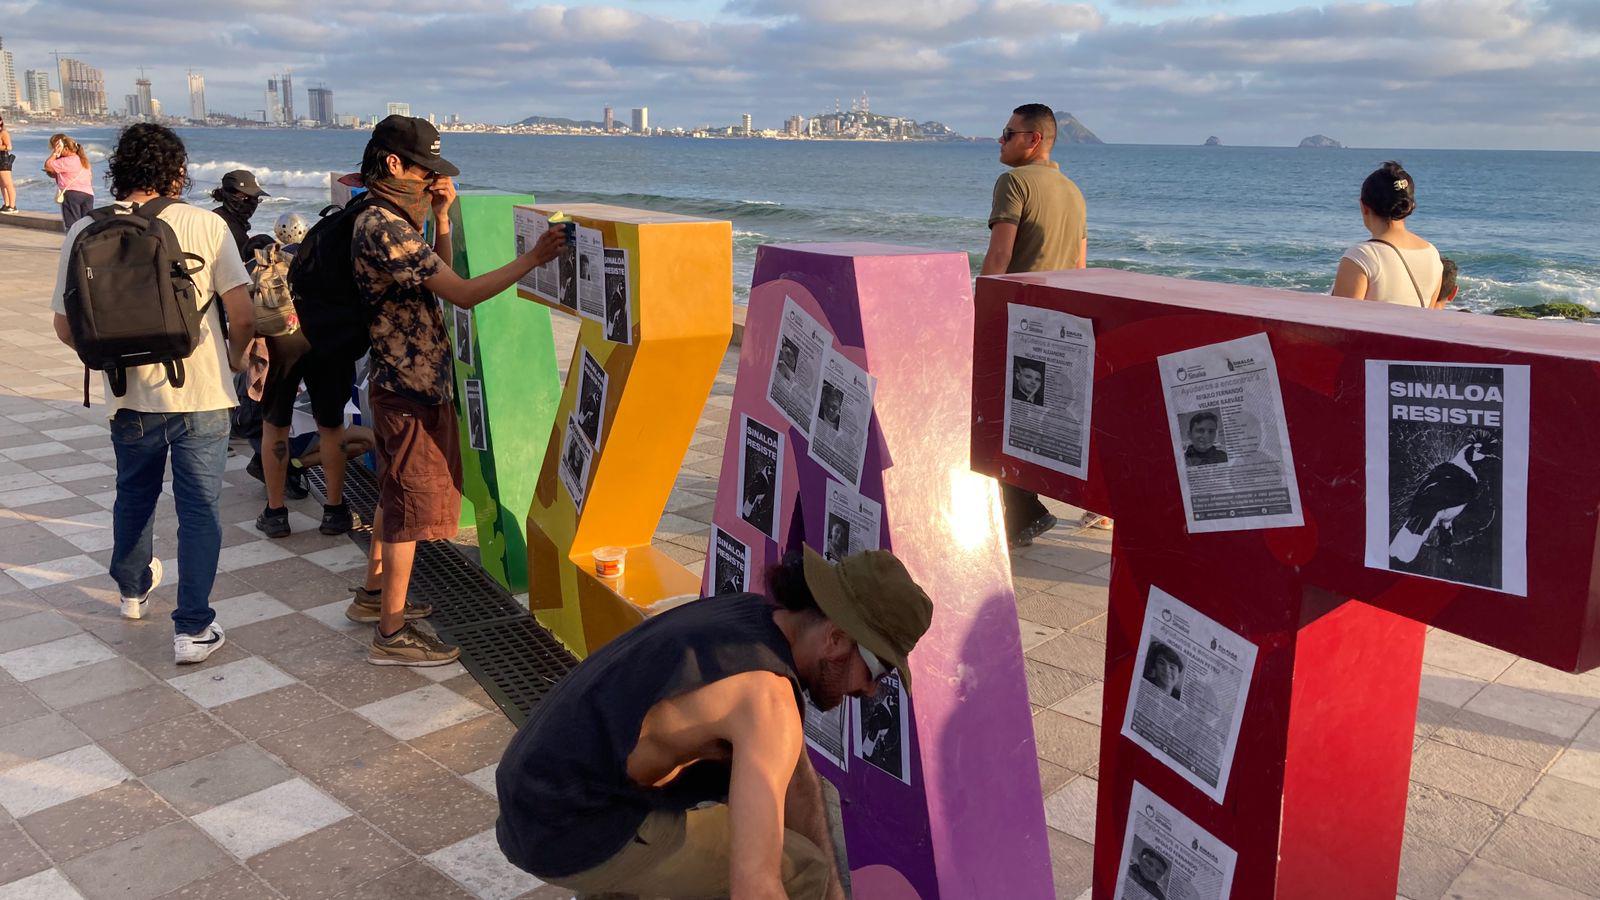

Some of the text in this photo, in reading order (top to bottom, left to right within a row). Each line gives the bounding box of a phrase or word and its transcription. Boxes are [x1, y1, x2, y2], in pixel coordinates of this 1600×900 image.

[1390, 381, 1503, 402] SINALOA
[1392, 404, 1501, 427] RESISTE
[746, 426, 778, 449] SINALOA
[746, 438, 777, 461] RESISTE
[717, 536, 745, 561] SINALOA
[717, 548, 744, 572] RESISTE
